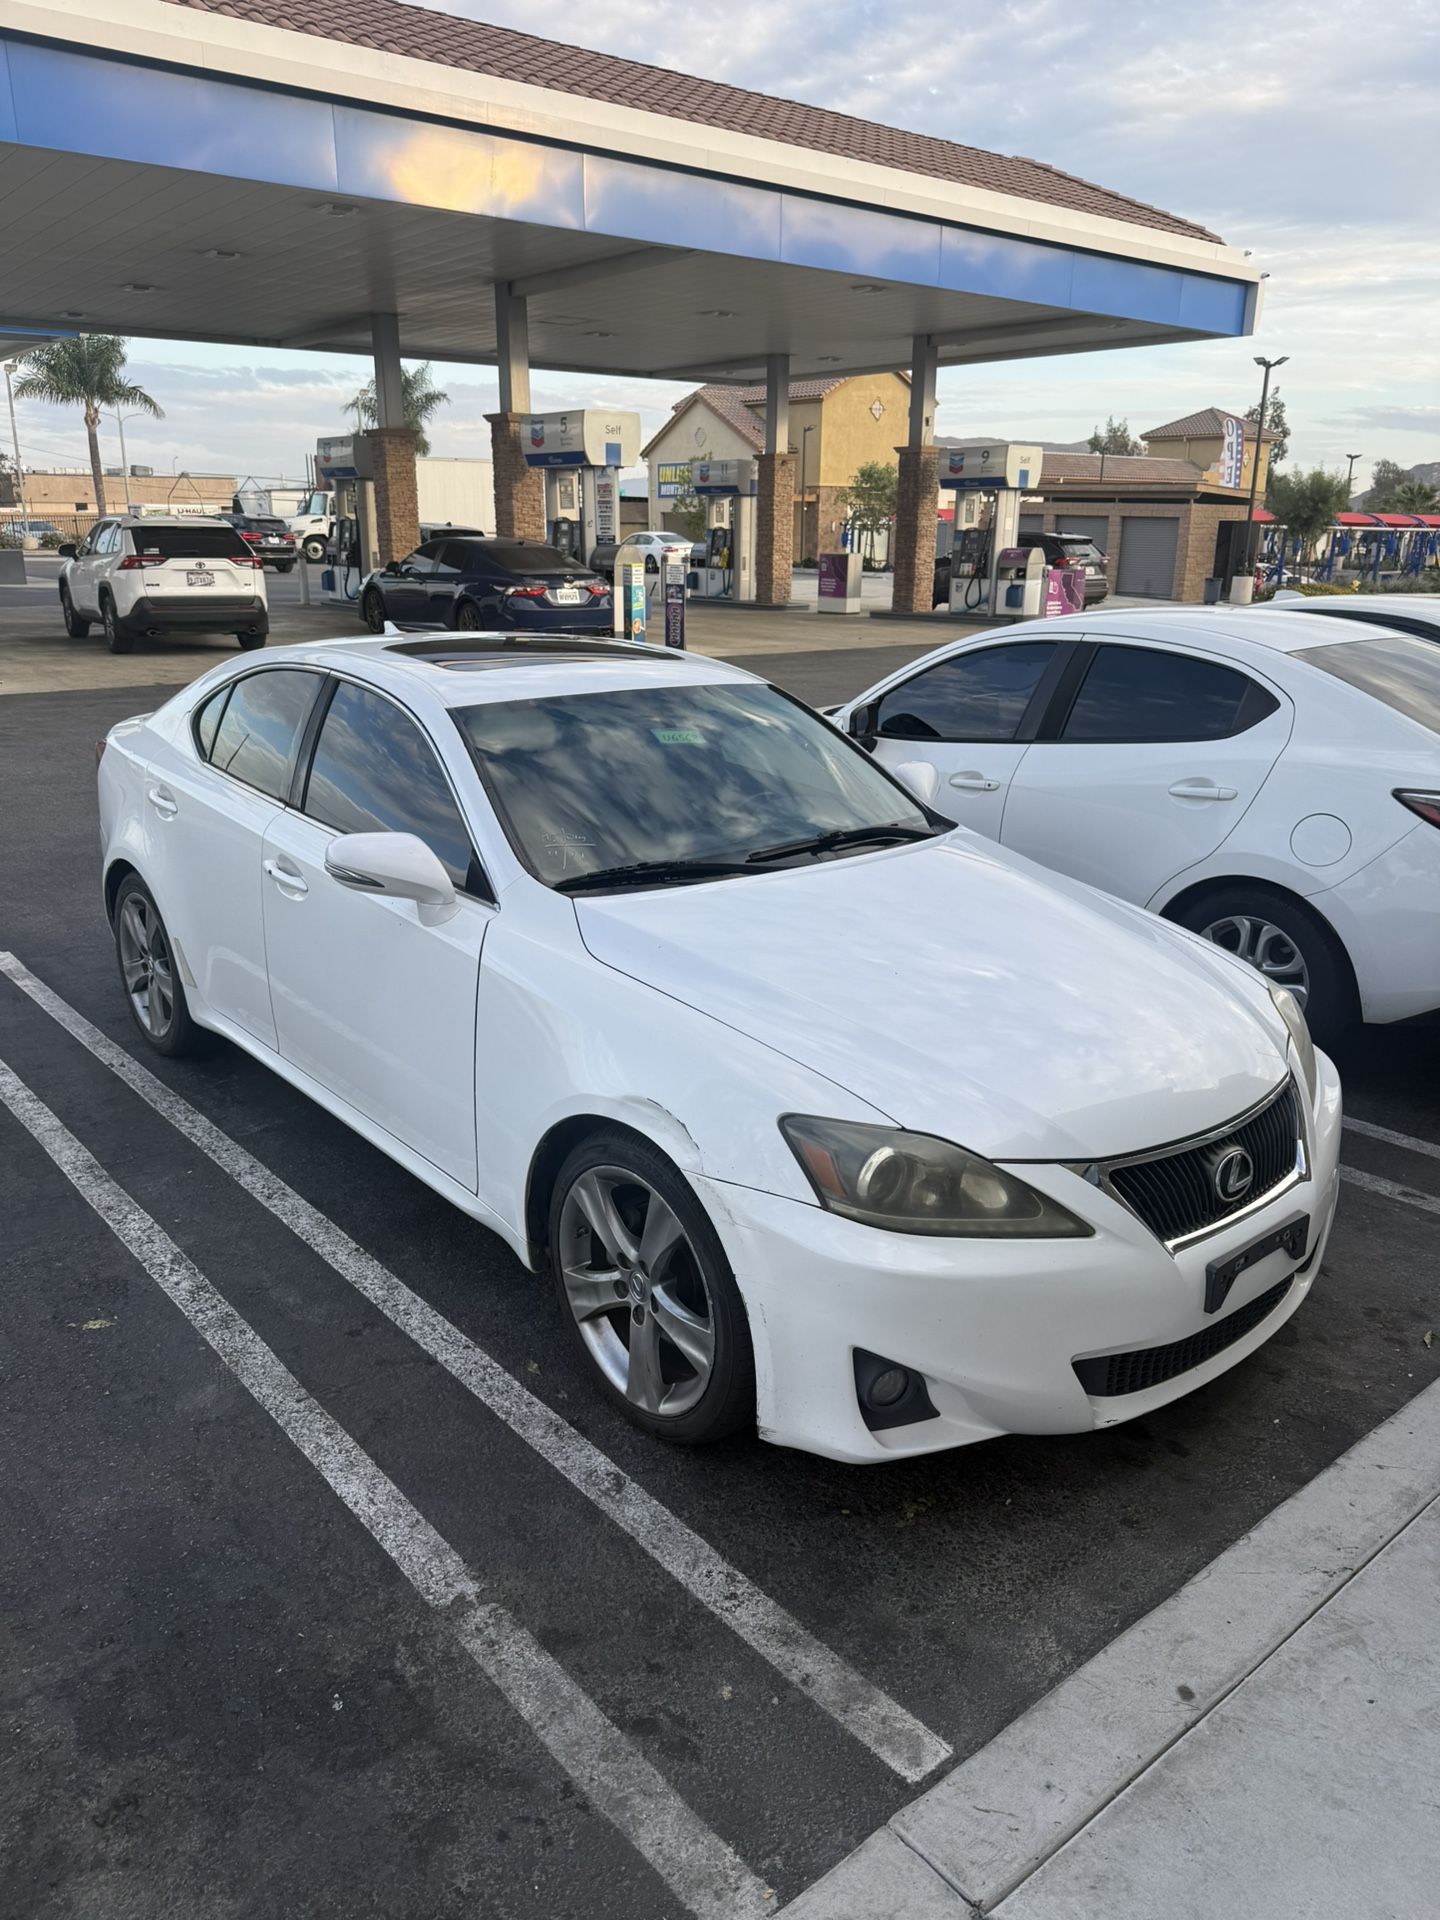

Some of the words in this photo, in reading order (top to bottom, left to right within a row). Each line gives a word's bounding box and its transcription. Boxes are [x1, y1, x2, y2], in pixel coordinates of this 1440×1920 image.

[560, 417, 568, 433] 5
[605, 424, 622, 435] Self
[981, 450, 990, 464] 9
